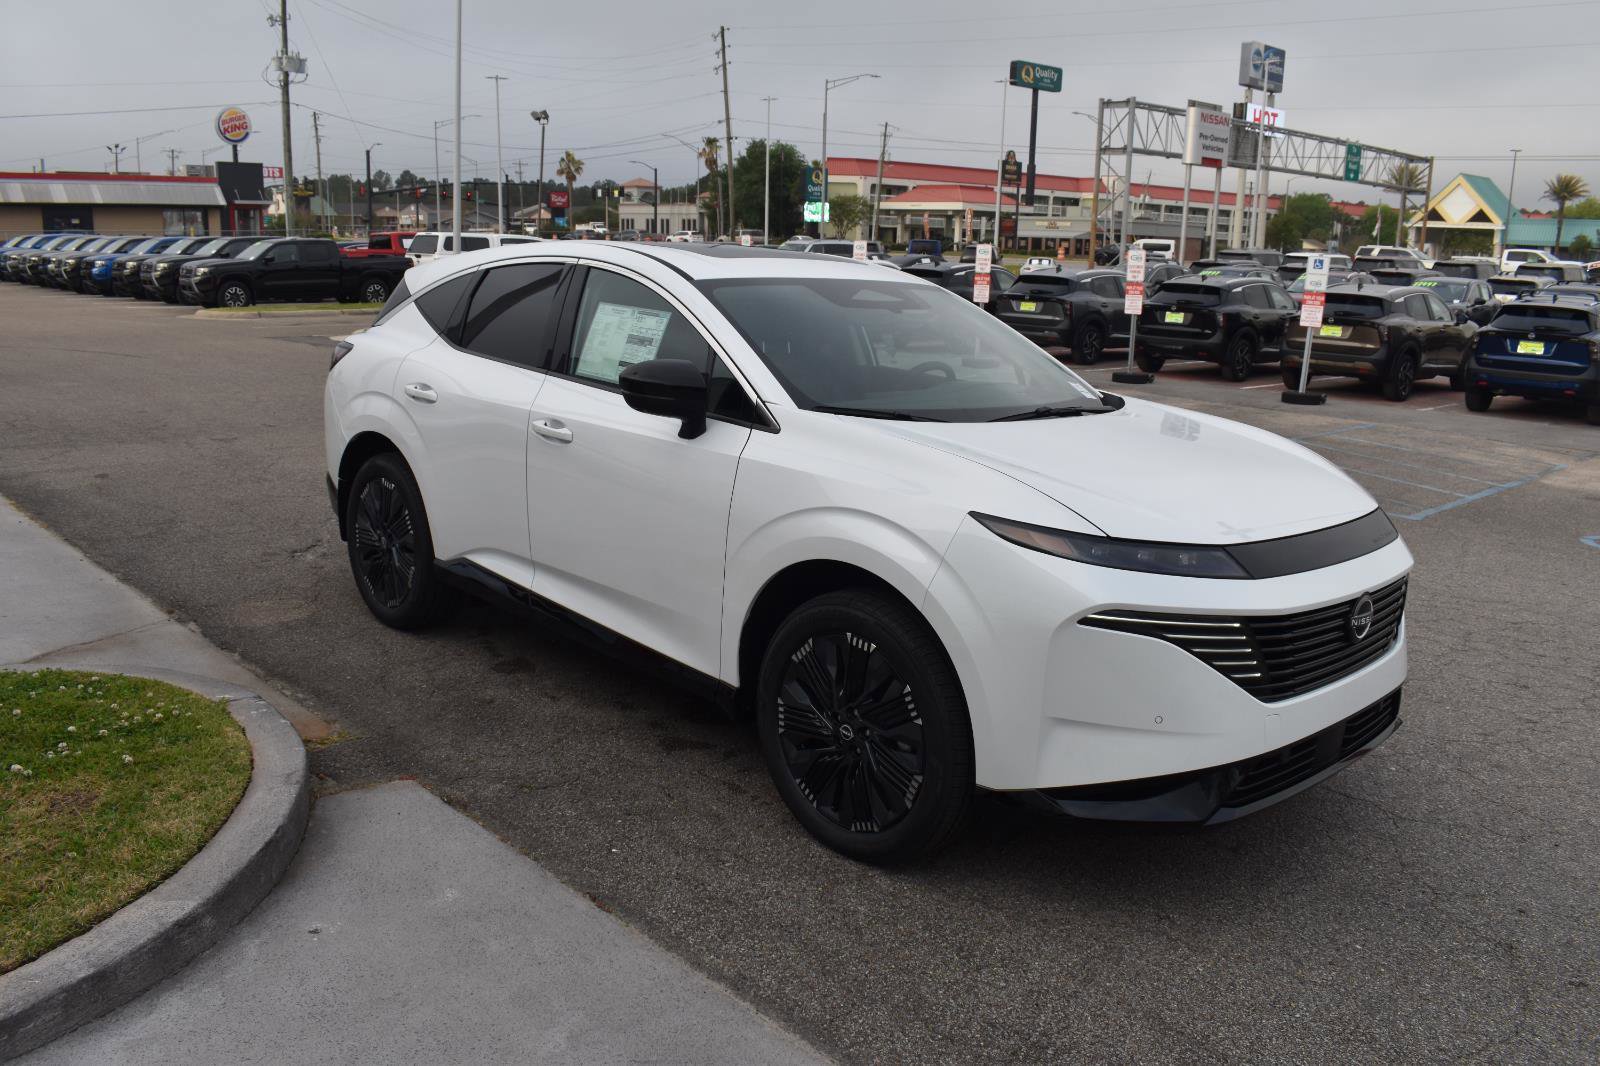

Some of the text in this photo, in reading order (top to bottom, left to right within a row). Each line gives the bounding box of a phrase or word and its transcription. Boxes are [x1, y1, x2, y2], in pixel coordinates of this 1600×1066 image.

[1035, 67, 1058, 81] Quality
[221, 114, 246, 126] BURGER
[1200, 112, 1230, 127] NISSAN
[1253, 108, 1279, 127] HOT
[223, 121, 248, 135] KING
[1199, 132, 1229, 144] Pre-Owned
[1202, 143, 1224, 153] Vehicles
